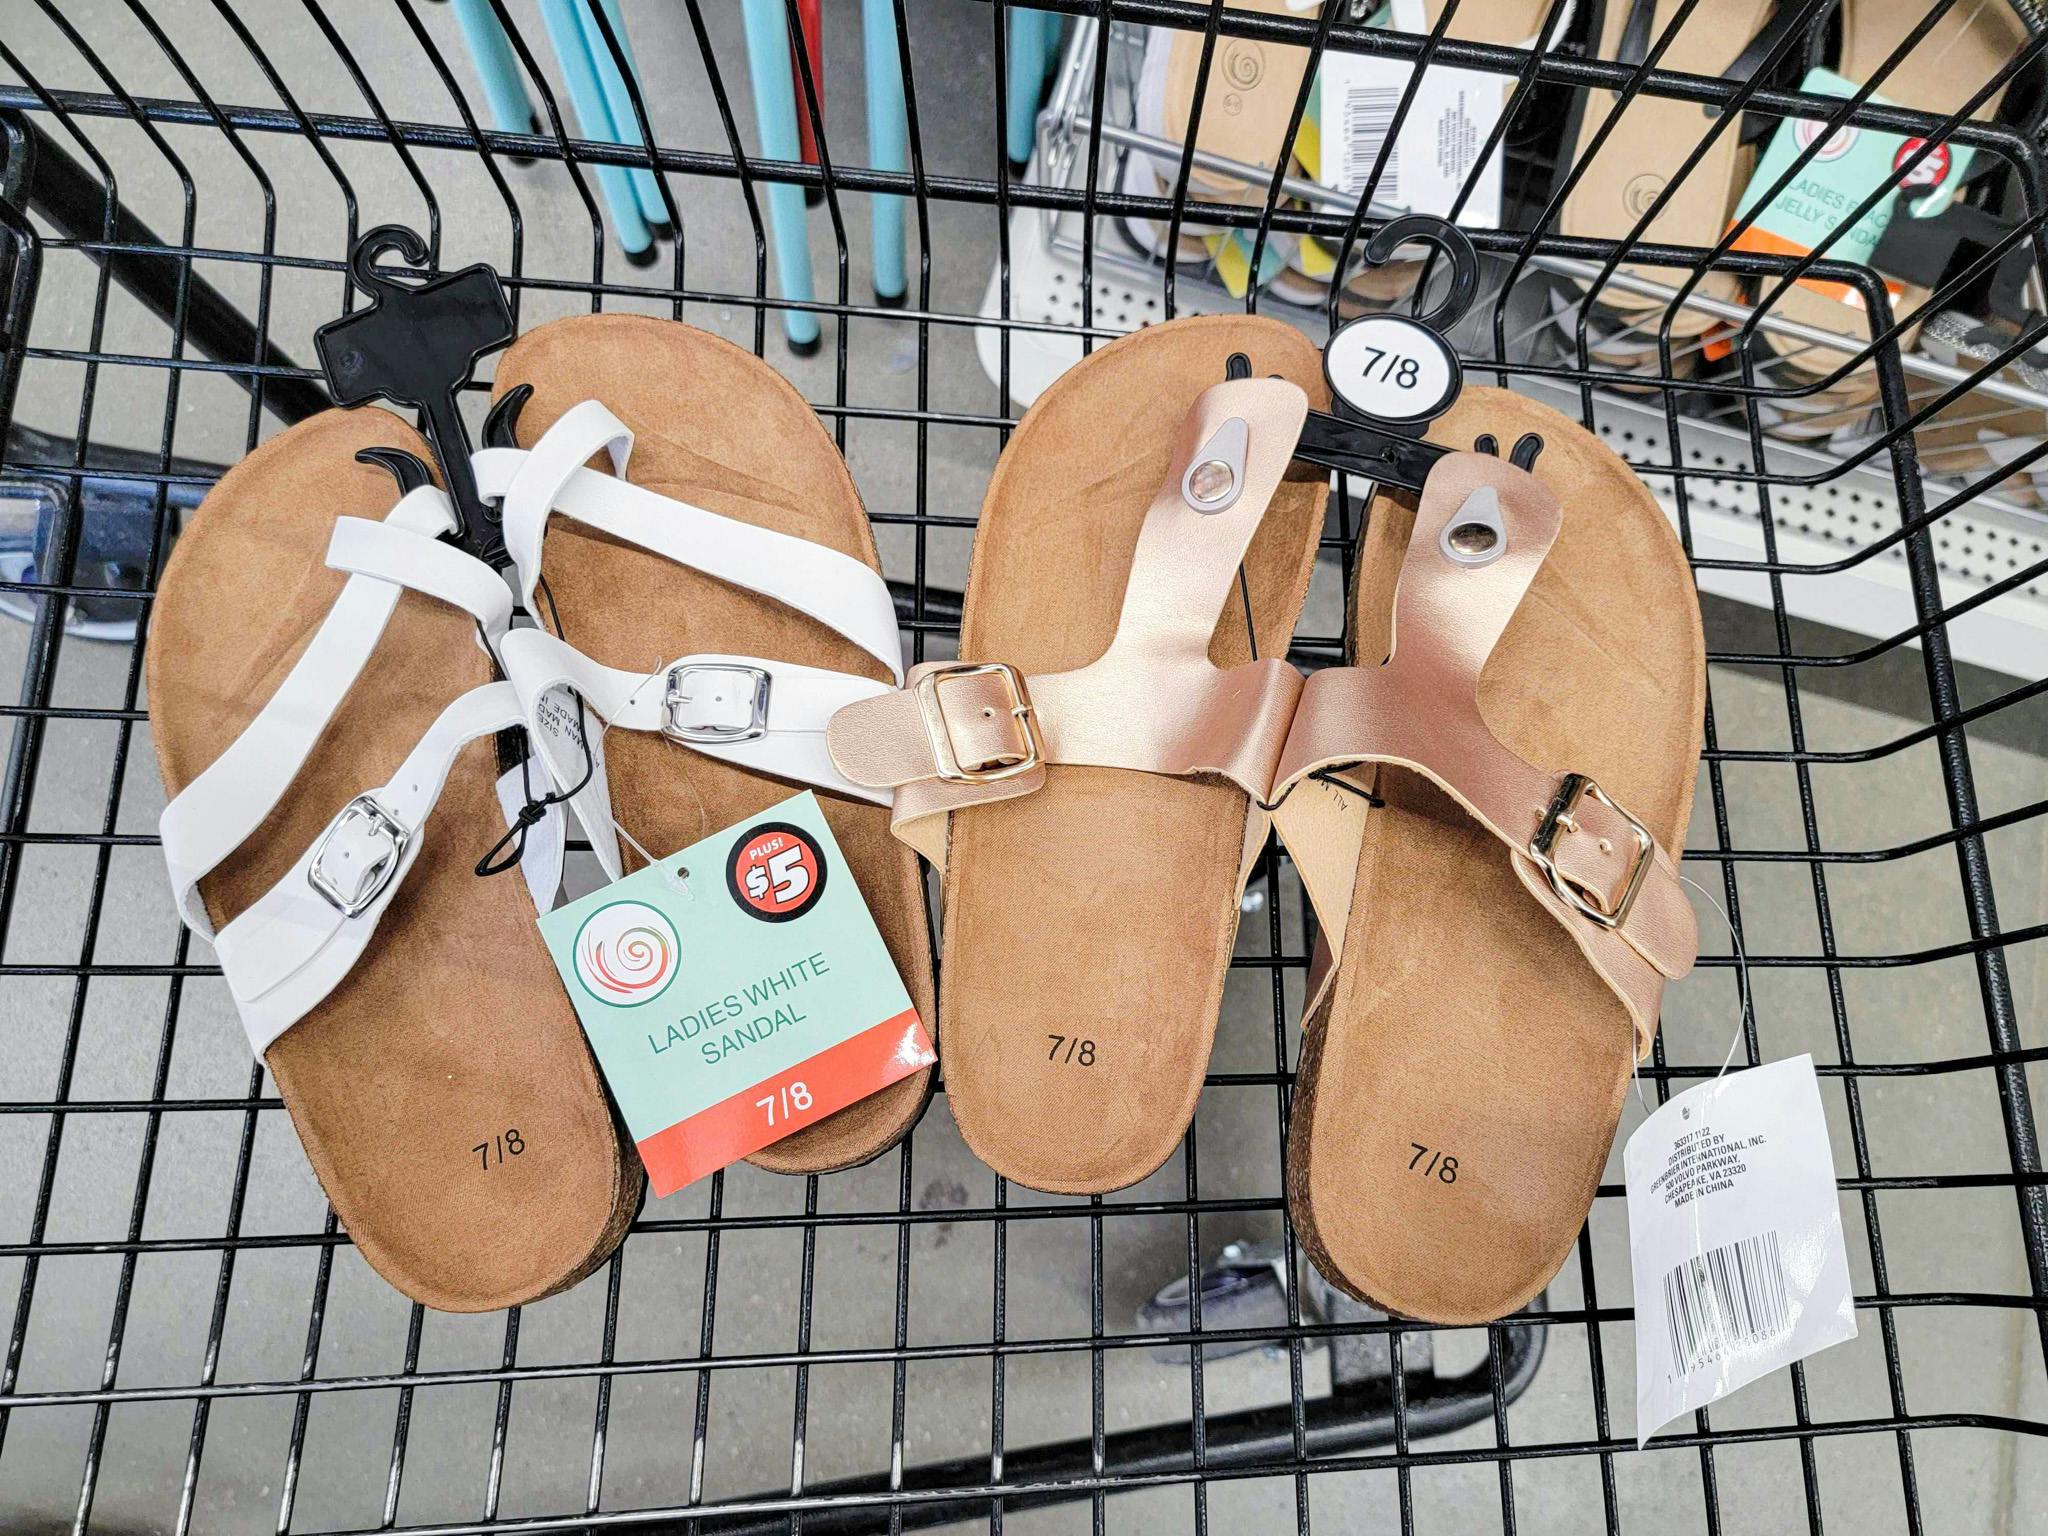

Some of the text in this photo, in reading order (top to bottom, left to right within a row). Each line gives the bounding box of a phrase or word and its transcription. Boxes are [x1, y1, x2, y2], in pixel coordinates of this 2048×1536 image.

[1775, 196, 1824, 223] JELLY
[1362, 346, 1420, 390] 7/8
[748, 836, 785, 861] PLUS!
[744, 844, 810, 905] $5
[647, 951, 830, 1055] LADIES WHITE
[700, 1003, 807, 1066] SANDAL
[1048, 1034, 1096, 1067] 7/8
[755, 1080, 814, 1127] 7/8
[472, 1128, 525, 1171] 7/8
[1408, 1142, 1459, 1184] 7/8
[1650, 1163, 1682, 1194] GREENBRIER
[1748, 1135, 1767, 1147] INC.
[1668, 1133, 1726, 1166] DISTRIBUTED BY
[1674, 1168, 1695, 1186] VOLVO
[1695, 1153, 1741, 1175] PARKWAY,
[1664, 1163, 1747, 1204] CHESAPEAKE, VA 23320
[1674, 1179, 1735, 1208] MADE IN CHINA
